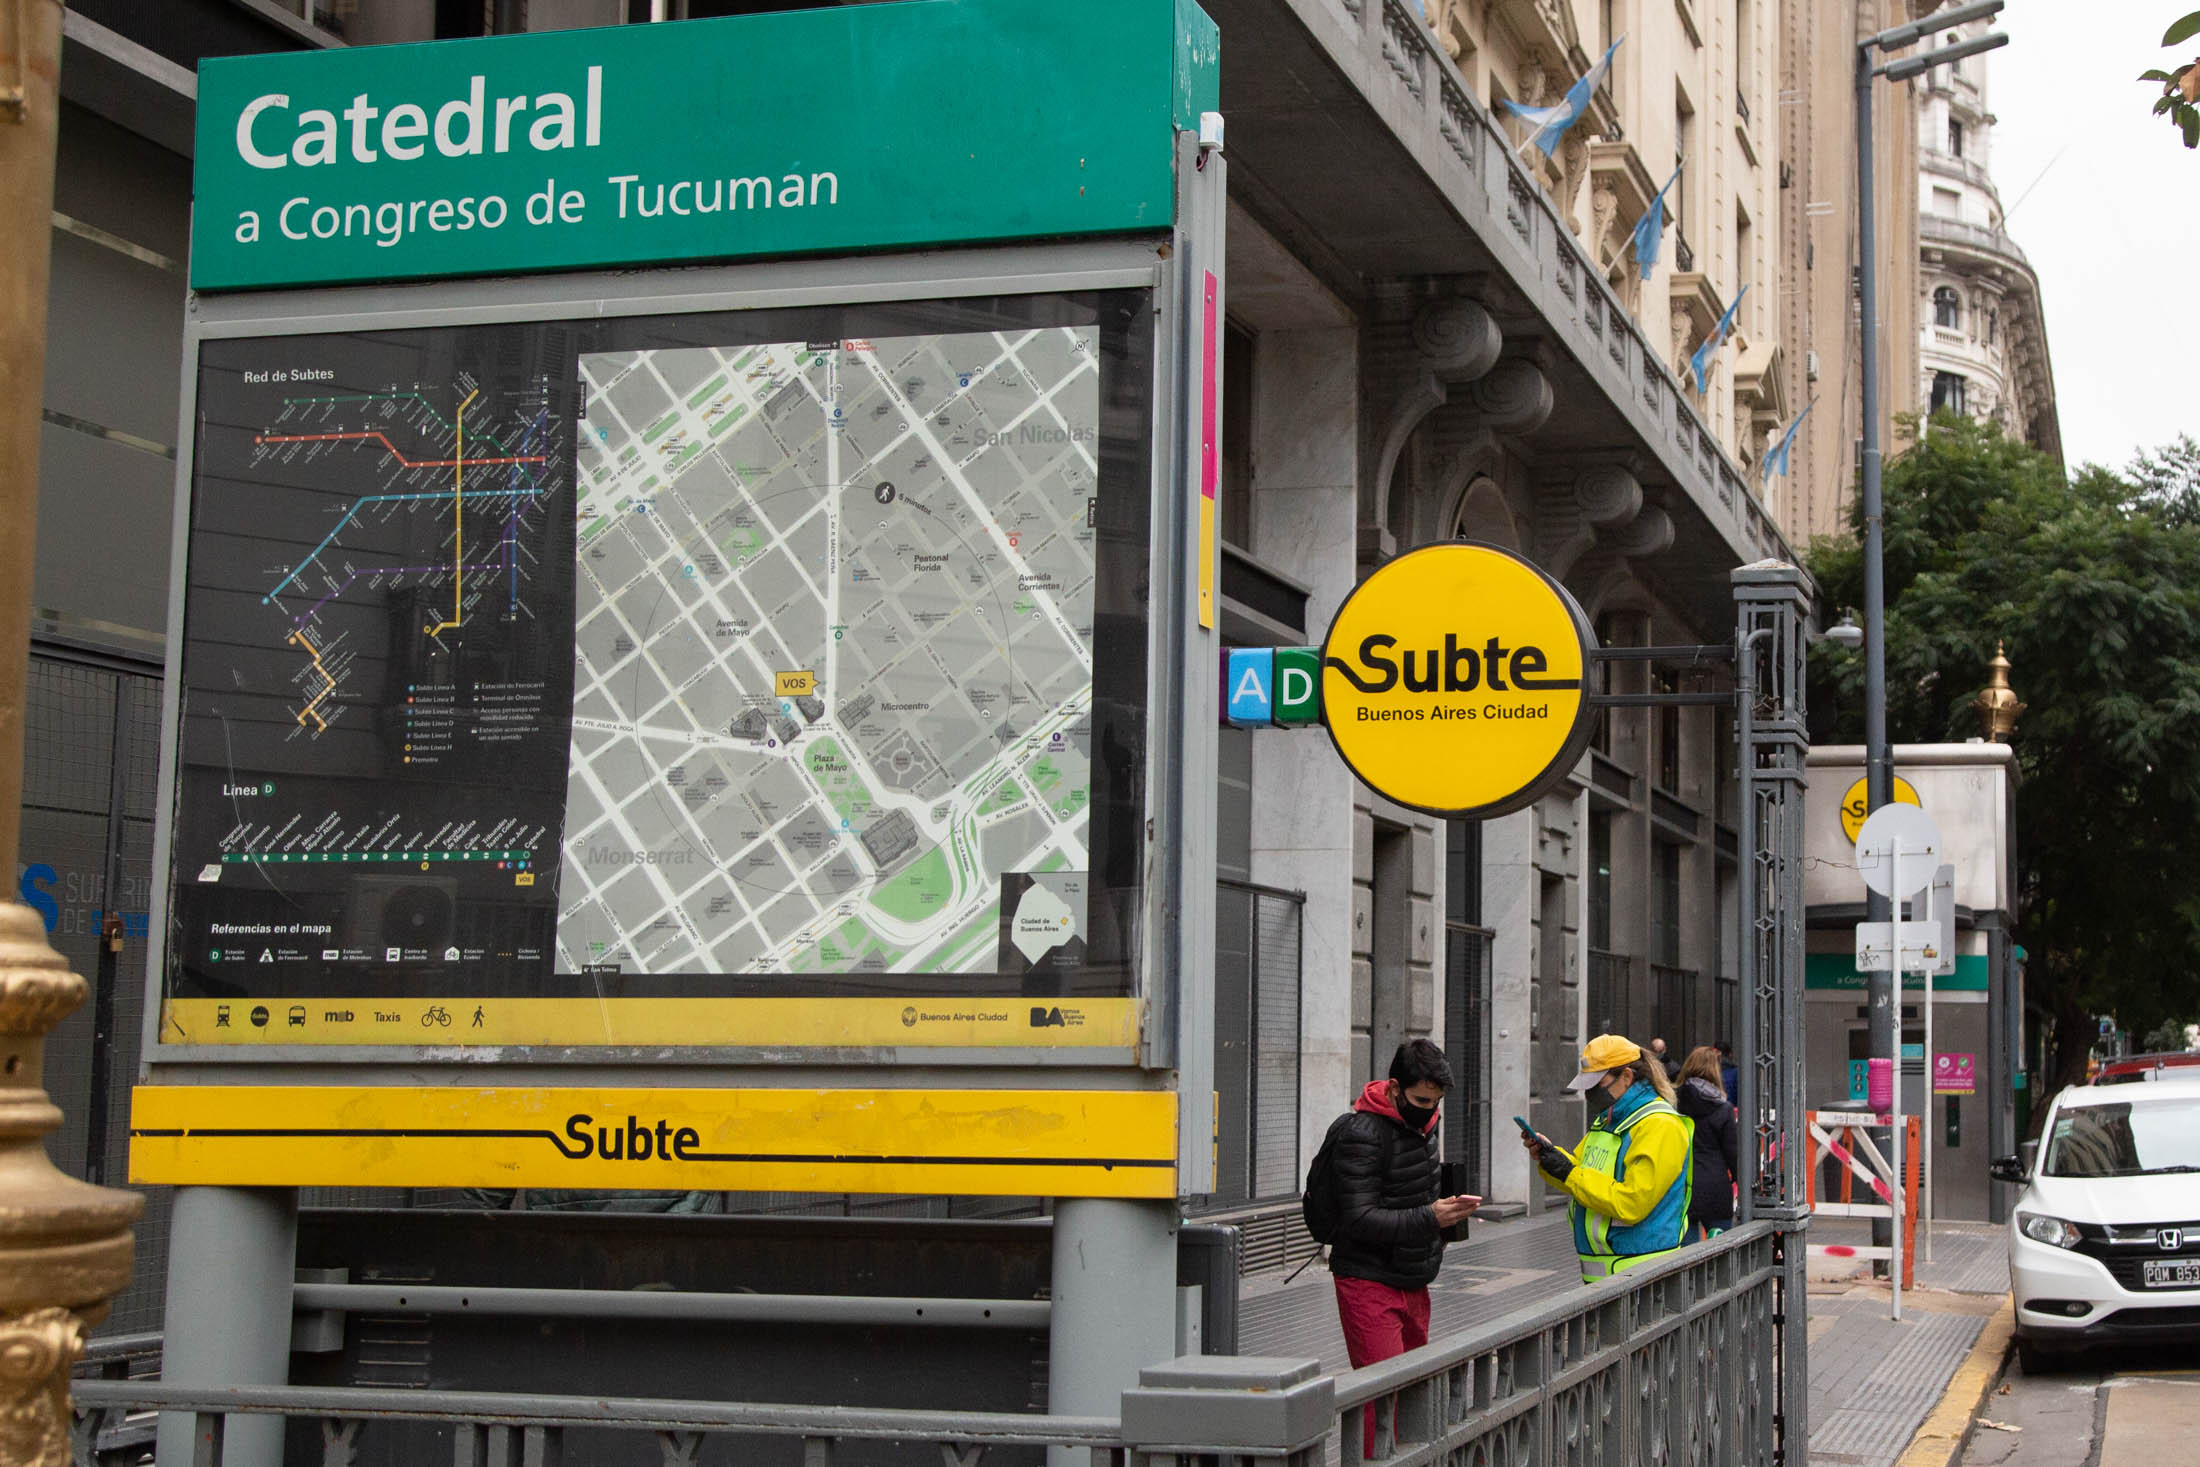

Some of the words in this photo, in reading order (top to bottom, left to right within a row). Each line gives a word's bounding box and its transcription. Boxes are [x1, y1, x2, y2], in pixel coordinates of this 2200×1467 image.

[236, 65, 602, 169] Catedral
[234, 211, 260, 244] a
[279, 187, 507, 247] Congreso
[525, 179, 585, 225] de
[609, 171, 839, 220] Tucuman
[244, 371, 269, 383] Red
[272, 370, 288, 382] de
[290, 368, 335, 381] Subtes
[973, 426, 1012, 447] San
[898, 493, 905, 501] 5
[904, 496, 932, 516] minutos
[914, 553, 949, 563] Peatonal
[914, 564, 942, 573] Florida
[1018, 573, 1052, 582] Avenida
[1018, 583, 1061, 592] Corrientes
[716, 619, 749, 628] Avenida
[716, 629, 726, 637] de
[727, 628, 750, 638] Mayo
[1358, 633, 1548, 693] Subte
[782, 678, 806, 689] VOS
[1232, 667, 1268, 704] A
[1282, 667, 1313, 706] D
[881, 703, 930, 712] Microcentro
[1356, 705, 1425, 722] Buenos
[1430, 704, 1477, 721] Aires
[1482, 703, 1548, 720] Ciudad
[814, 754, 835, 763] Plaza
[813, 765, 824, 773] de
[825, 763, 848, 774] Mayo
[223, 783, 258, 797] Línea
[315, 811, 338, 833] Carranza
[219, 824, 243, 847] Congreso
[244, 825, 271, 852] Juramento
[343, 837, 357, 851] Plaza
[356, 825, 370, 839] Italia
[481, 818, 508, 845] Tribunales
[516, 824, 529, 838] Julio
[524, 825, 546, 849] Catedral
[264, 838, 276, 852] José
[283, 834, 302, 851] Olleros
[323, 830, 345, 851] Palermo
[383, 833, 402, 851] Bulnes
[464, 833, 481, 850] Callao
[588, 846, 694, 865] Monserrat
[63, 908, 87, 934] DE
[211, 923, 271, 934] Referencias
[274, 925, 287, 934] en
[290, 923, 300, 934] el
[302, 924, 332, 936] mapa
[374, 1011, 401, 1023] Taxis
[921, 1013, 951, 1022] Buenos
[953, 1013, 976, 1022] Aires
[978, 1013, 1008, 1022] Ciudad
[1030, 1007, 1065, 1028] BA
[563, 1115, 701, 1162] Subte
[2146, 1266, 2170, 1282] PQM
[2176, 1265, 2200, 1281] 853
